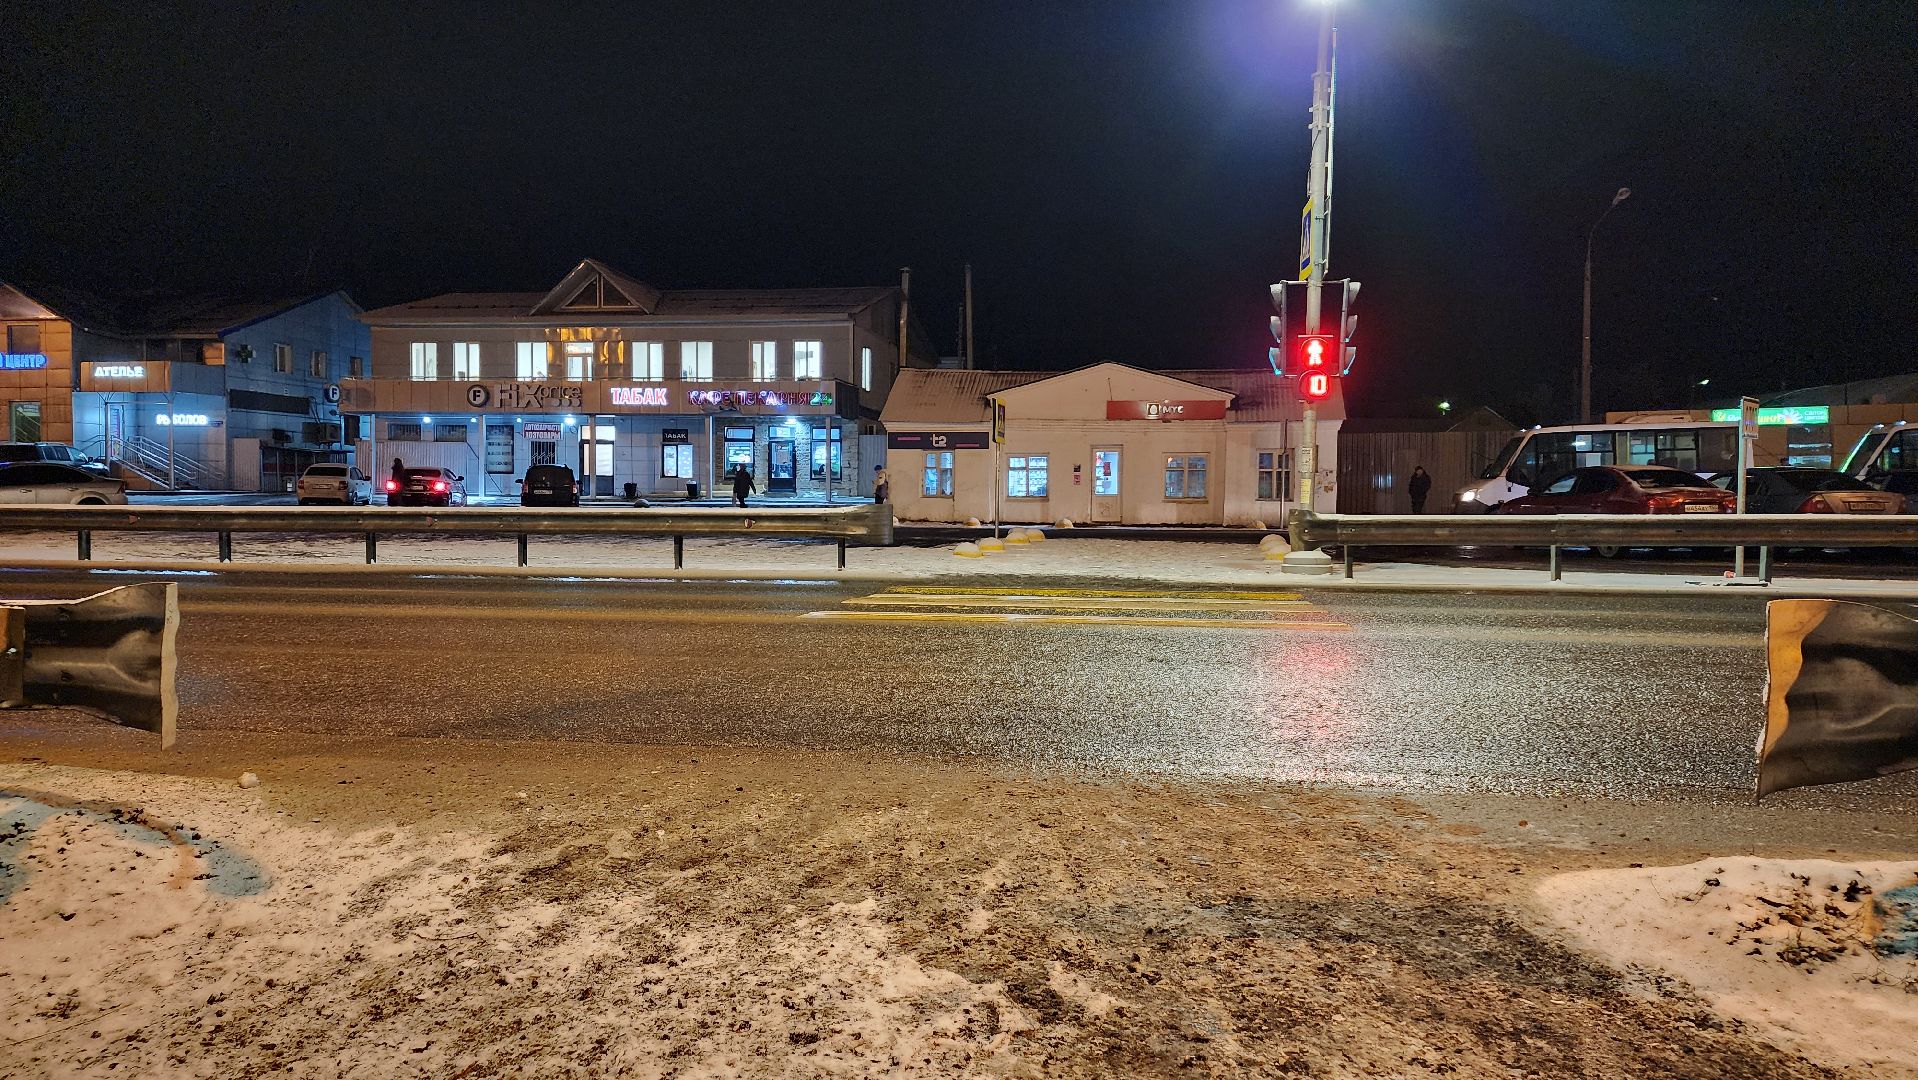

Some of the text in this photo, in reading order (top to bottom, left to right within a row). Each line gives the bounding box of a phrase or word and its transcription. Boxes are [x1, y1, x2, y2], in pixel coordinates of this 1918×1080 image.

[5, 354, 45, 368] ЦЕНТР
[94, 366, 144, 377] АТЕЛЬЕ
[611, 387, 668, 406] ТАБАК
[687, 390, 731, 405] КАФЕ
[734, 390, 809, 405] ПЕКАРНЯ
[930, 433, 947, 448] t2
